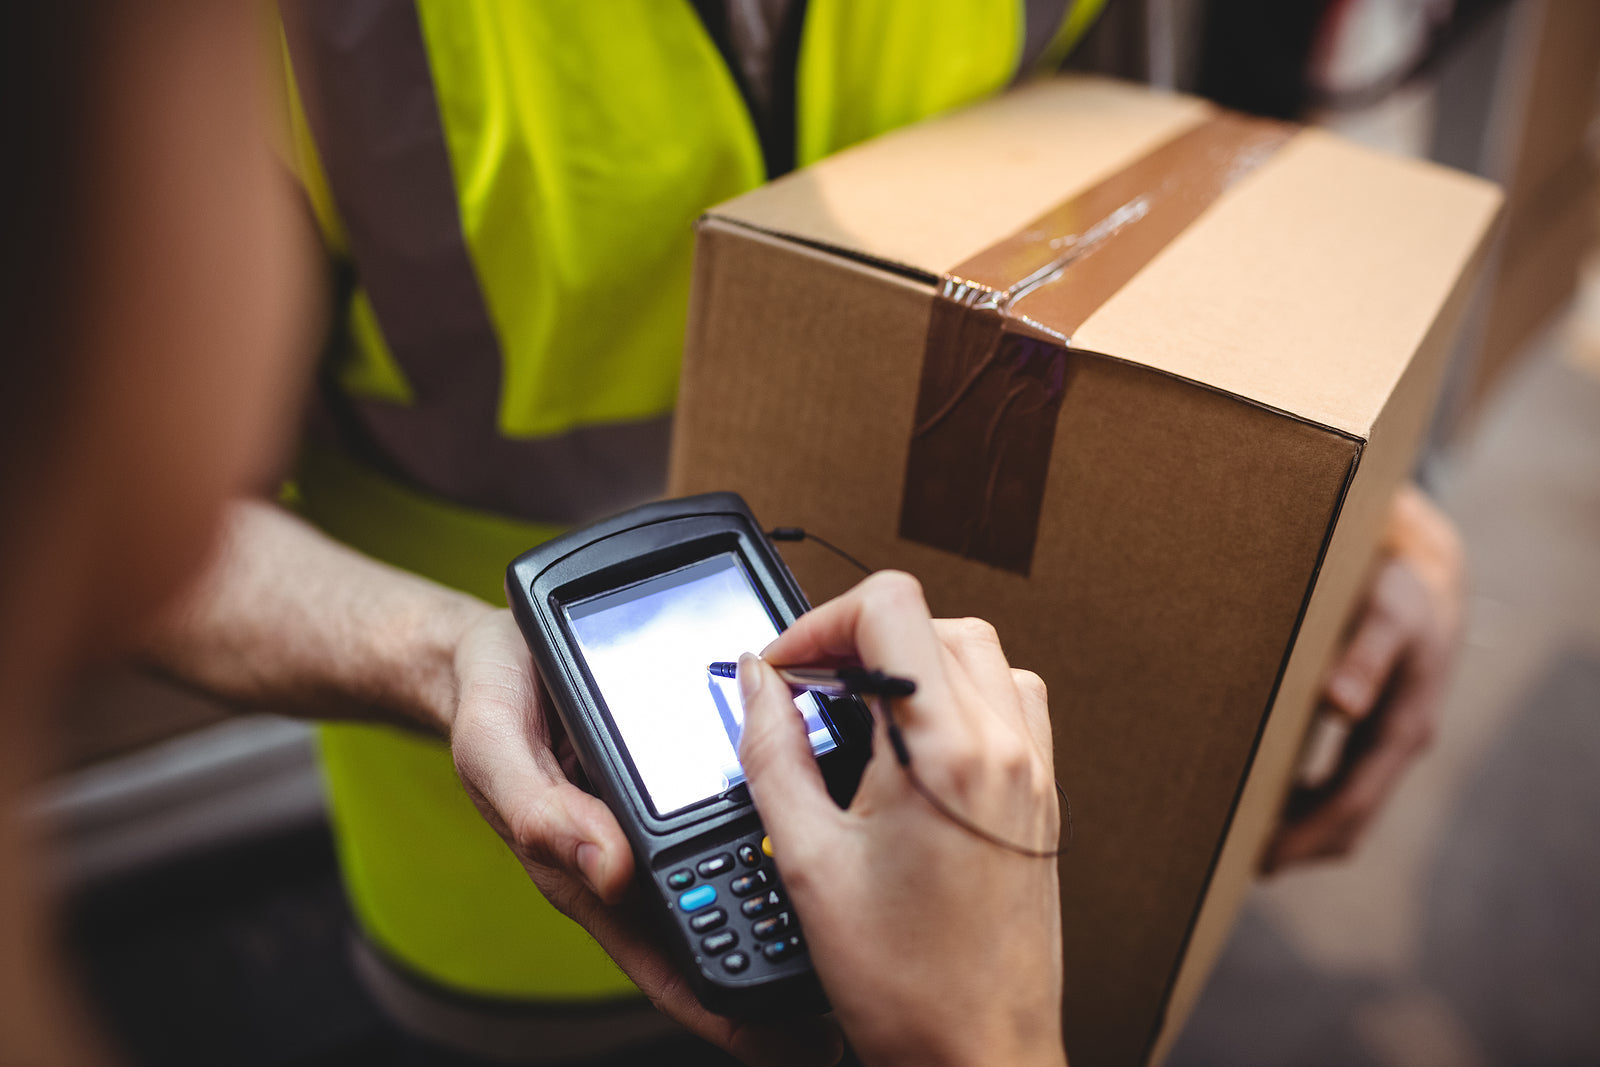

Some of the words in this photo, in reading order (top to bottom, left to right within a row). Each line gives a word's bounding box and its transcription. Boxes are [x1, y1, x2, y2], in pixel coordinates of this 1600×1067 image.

[757, 870, 767, 882] 1
[769, 890, 779, 904] 4
[779, 912, 789, 926] 7
